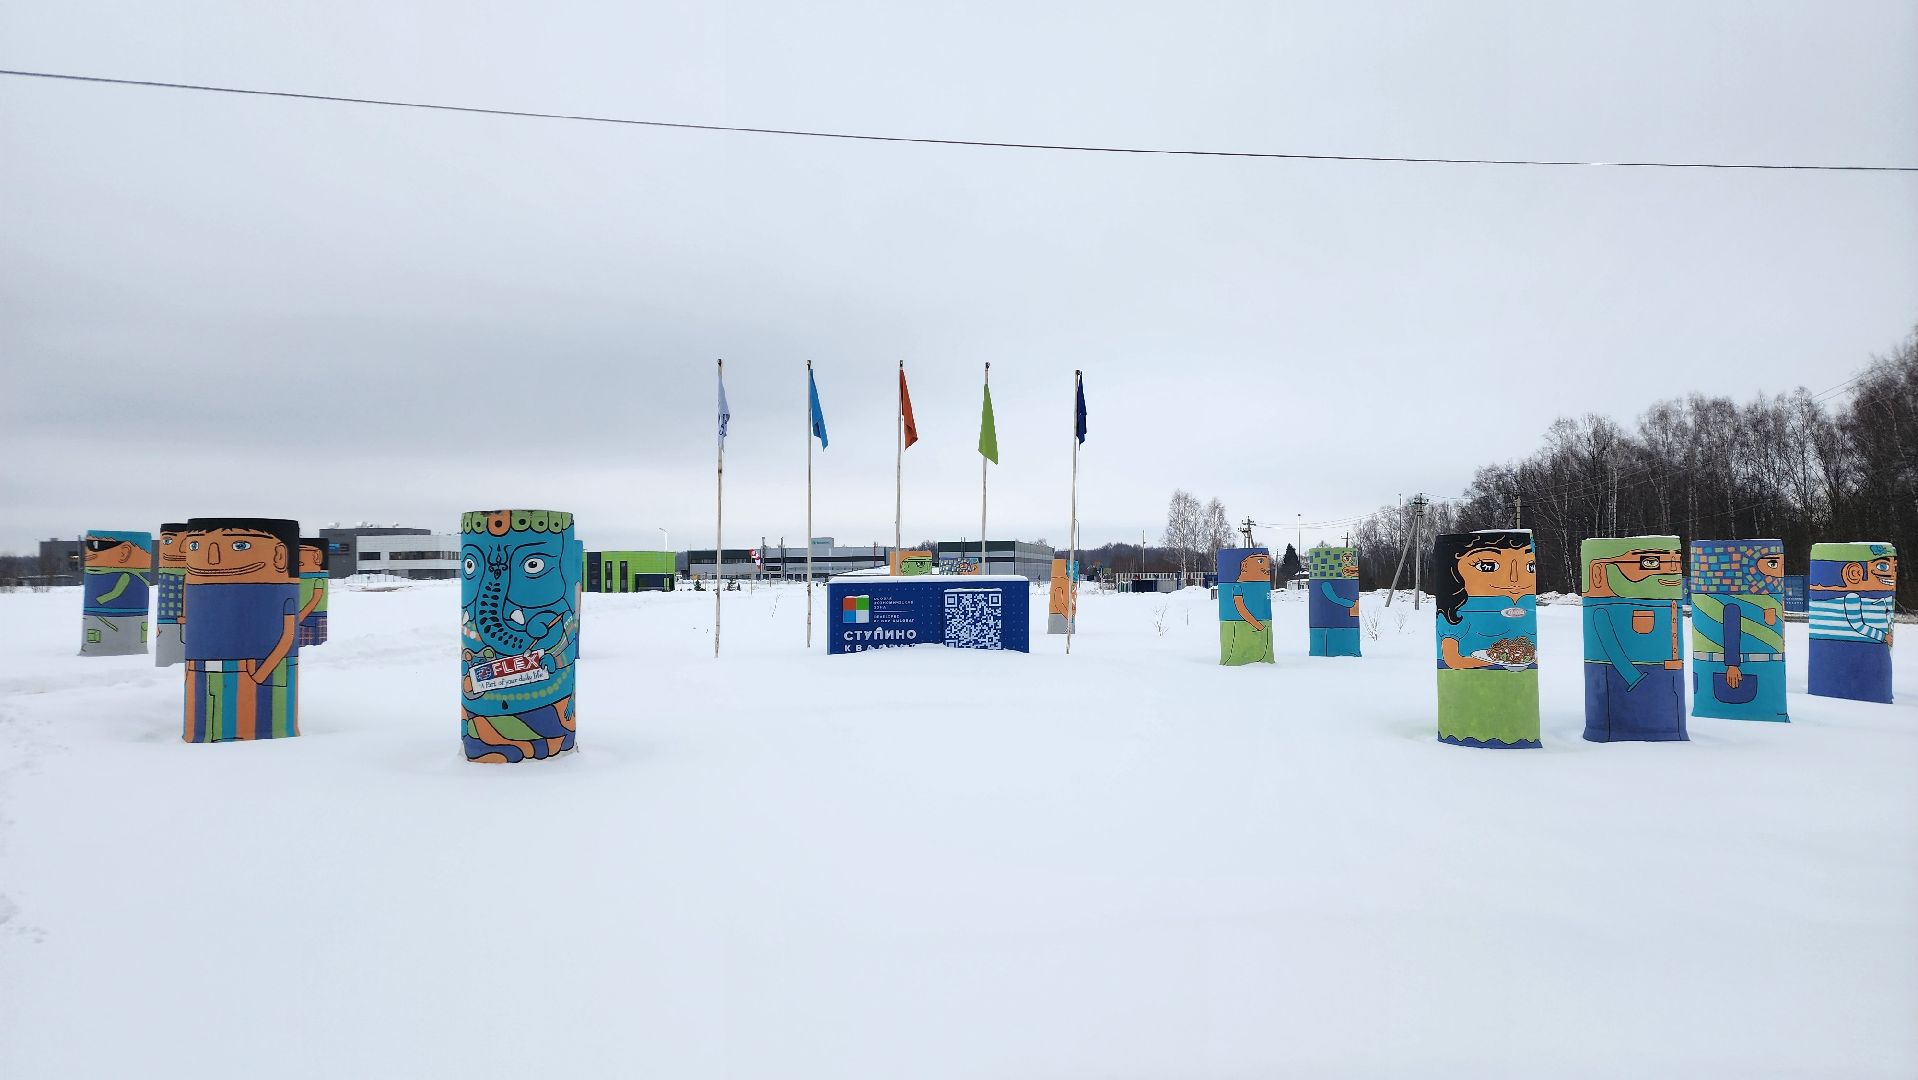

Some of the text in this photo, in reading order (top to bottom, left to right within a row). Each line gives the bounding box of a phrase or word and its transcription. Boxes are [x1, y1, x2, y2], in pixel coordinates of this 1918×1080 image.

[843, 628, 917, 641] СТУПИНО
[492, 653, 539, 676] FLEX
[505, 678, 518, 687] your
